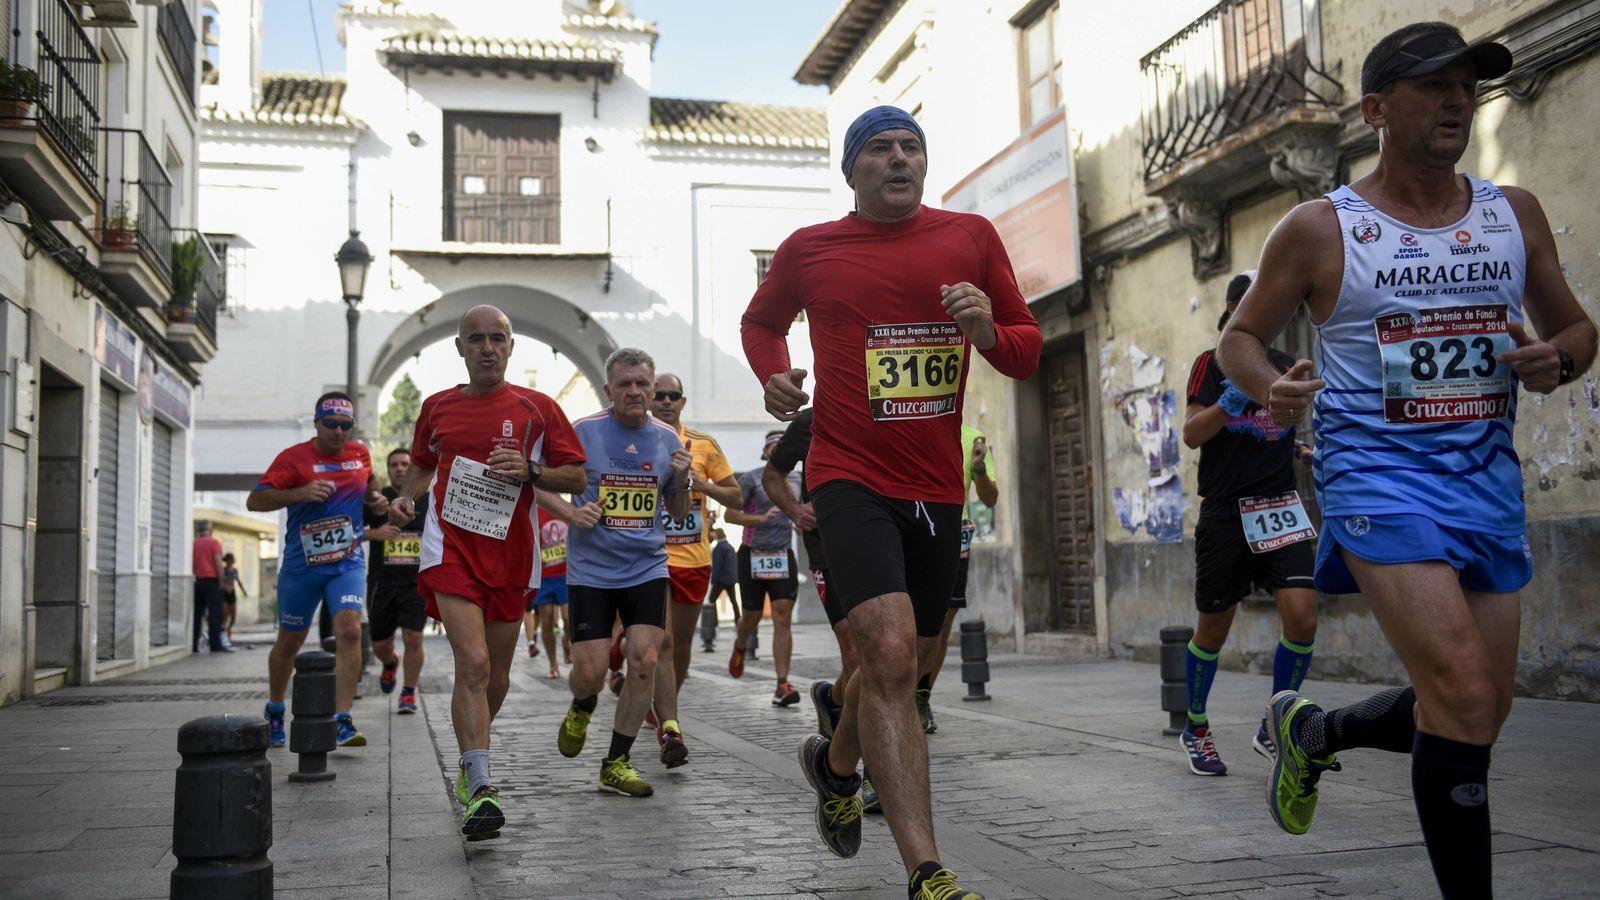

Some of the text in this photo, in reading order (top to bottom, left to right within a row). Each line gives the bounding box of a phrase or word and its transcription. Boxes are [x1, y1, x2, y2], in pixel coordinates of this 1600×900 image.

[1451, 243, 1490, 255] mayfo
[1375, 261, 1511, 288] MARACENA
[1395, 289, 1422, 298] CLUB
[1440, 285, 1499, 295] ATLETISMO
[1434, 312, 1461, 321] Premio
[1465, 312, 1473, 320] de
[1476, 311, 1497, 319] Fondo
[908, 327, 930, 335] Premio
[1452, 322, 1483, 330] Cruzcampo
[1486, 322, 1506, 330] 2018
[948, 336, 961, 344] 2018
[1410, 336, 1497, 381] 823
[879, 354, 959, 388] 3166
[883, 399, 946, 415] Cruzcampo
[1404, 400, 1496, 418] Cruzcampo
[609, 461, 637, 470] LISBOA
[460, 480, 484, 492] CORRO
[486, 489, 515, 502] CONTRA
[457, 497, 480, 510] aecc
[470, 492, 500, 505] CANCER
[606, 492, 654, 512] 3106
[606, 517, 647, 528] Cruzcampo
[1256, 510, 1297, 534] 139
[312, 528, 347, 548] 542
[1258, 531, 1305, 550] Cruzcampo
[390, 542, 419, 553] 3146
[758, 558, 782, 569] 136
